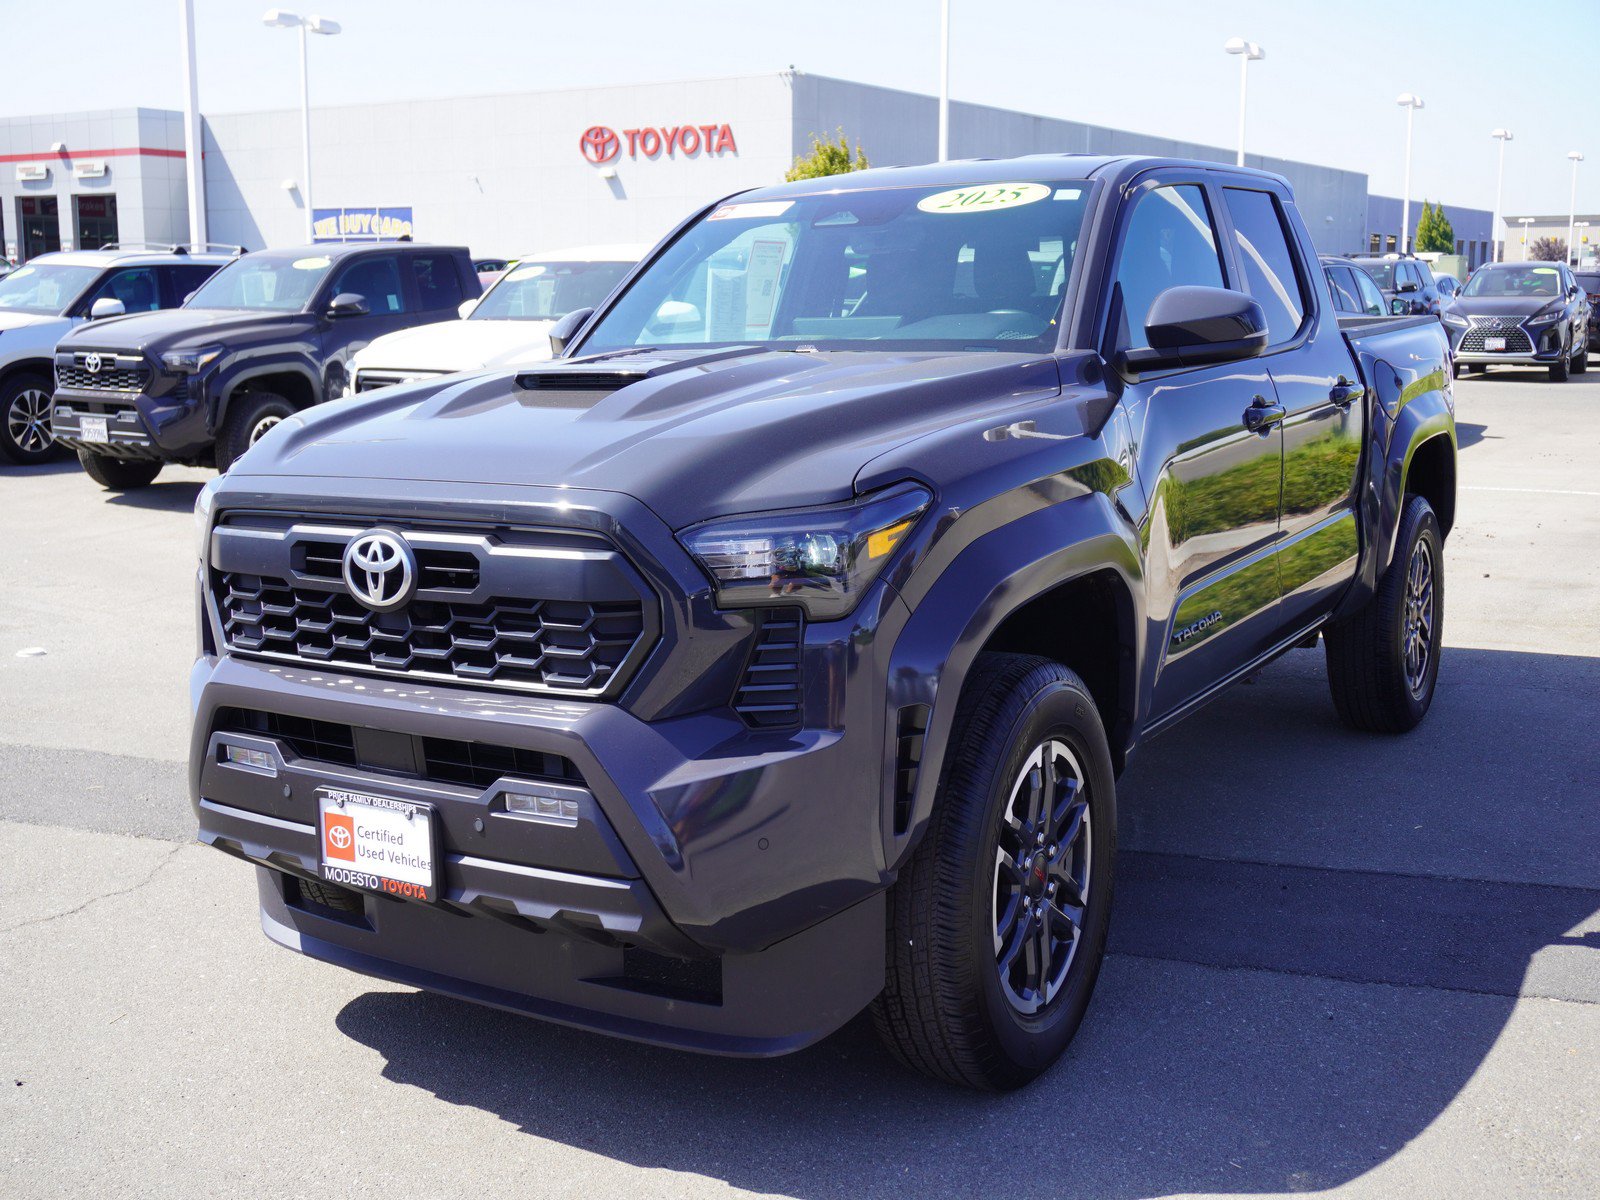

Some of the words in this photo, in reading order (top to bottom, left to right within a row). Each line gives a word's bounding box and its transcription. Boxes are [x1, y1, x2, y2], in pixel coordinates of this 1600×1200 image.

[623, 123, 737, 157] TOYOTA
[938, 186, 1030, 209] 2025
[313, 216, 337, 236] WE
[339, 214, 371, 234] BUY
[371, 214, 412, 236] CARS
[1173, 611, 1222, 643] TACOMA
[328, 791, 348, 802] PRICE
[349, 793, 372, 805] FAMILY
[373, 797, 417, 813] DEALERSHIPS
[357, 825, 404, 845] Certified
[358, 845, 385, 861] Used
[387, 850, 432, 871] Vehicles
[325, 866, 378, 889] MODESTO
[381, 878, 427, 900] TOYOTA
